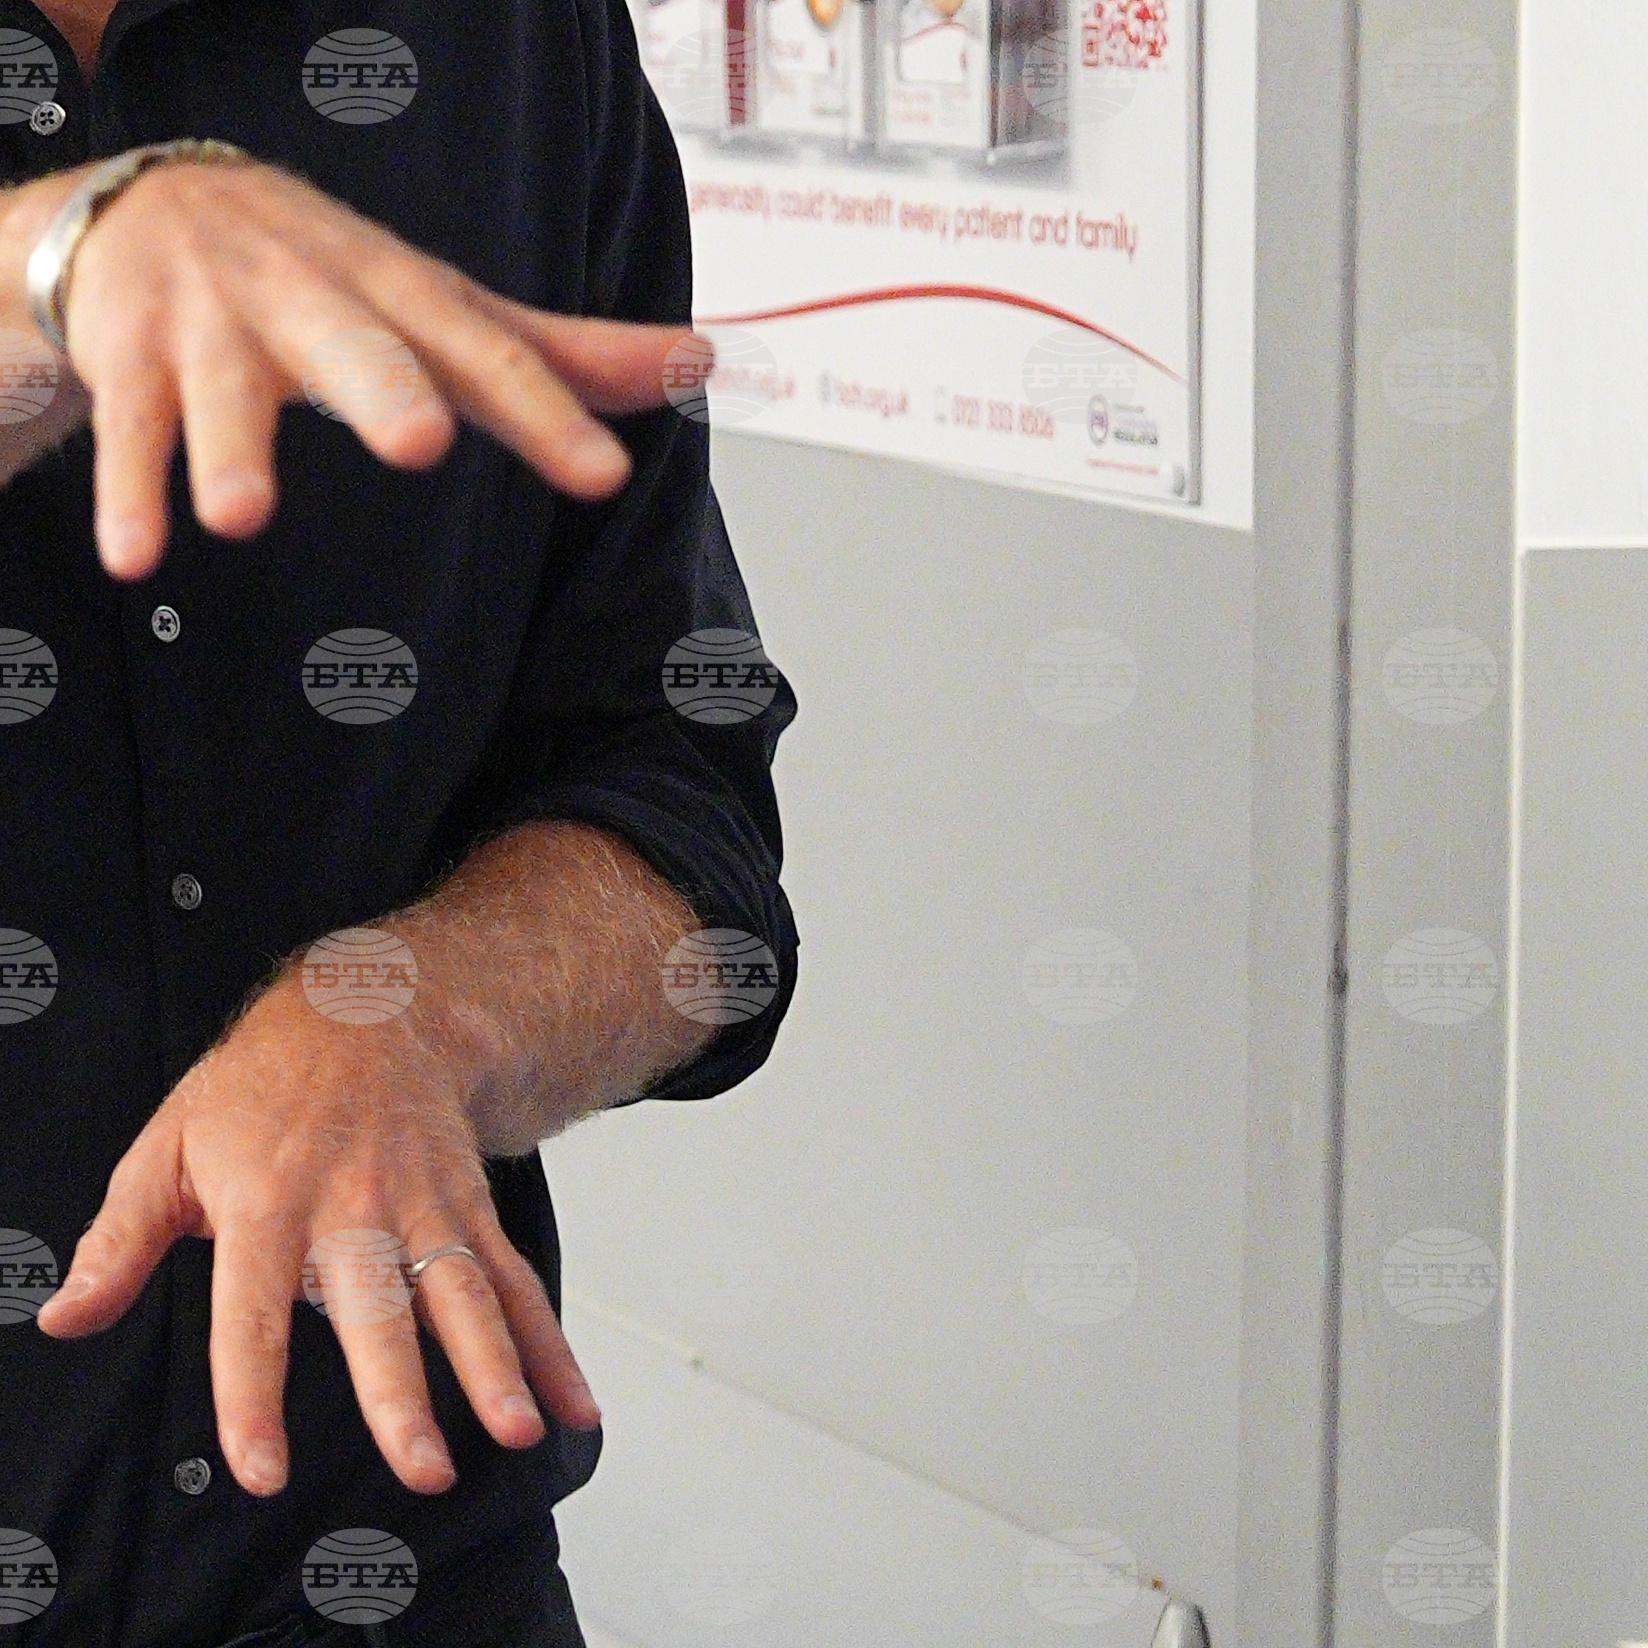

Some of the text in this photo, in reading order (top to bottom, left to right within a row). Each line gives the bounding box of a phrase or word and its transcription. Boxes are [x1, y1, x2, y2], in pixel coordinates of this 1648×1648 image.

[830, 189, 893, 226] benefit
[899, 201, 948, 244] every
[954, 202, 1023, 244] patient
[1030, 208, 1069, 246] and
[1076, 210, 1139, 263] family
